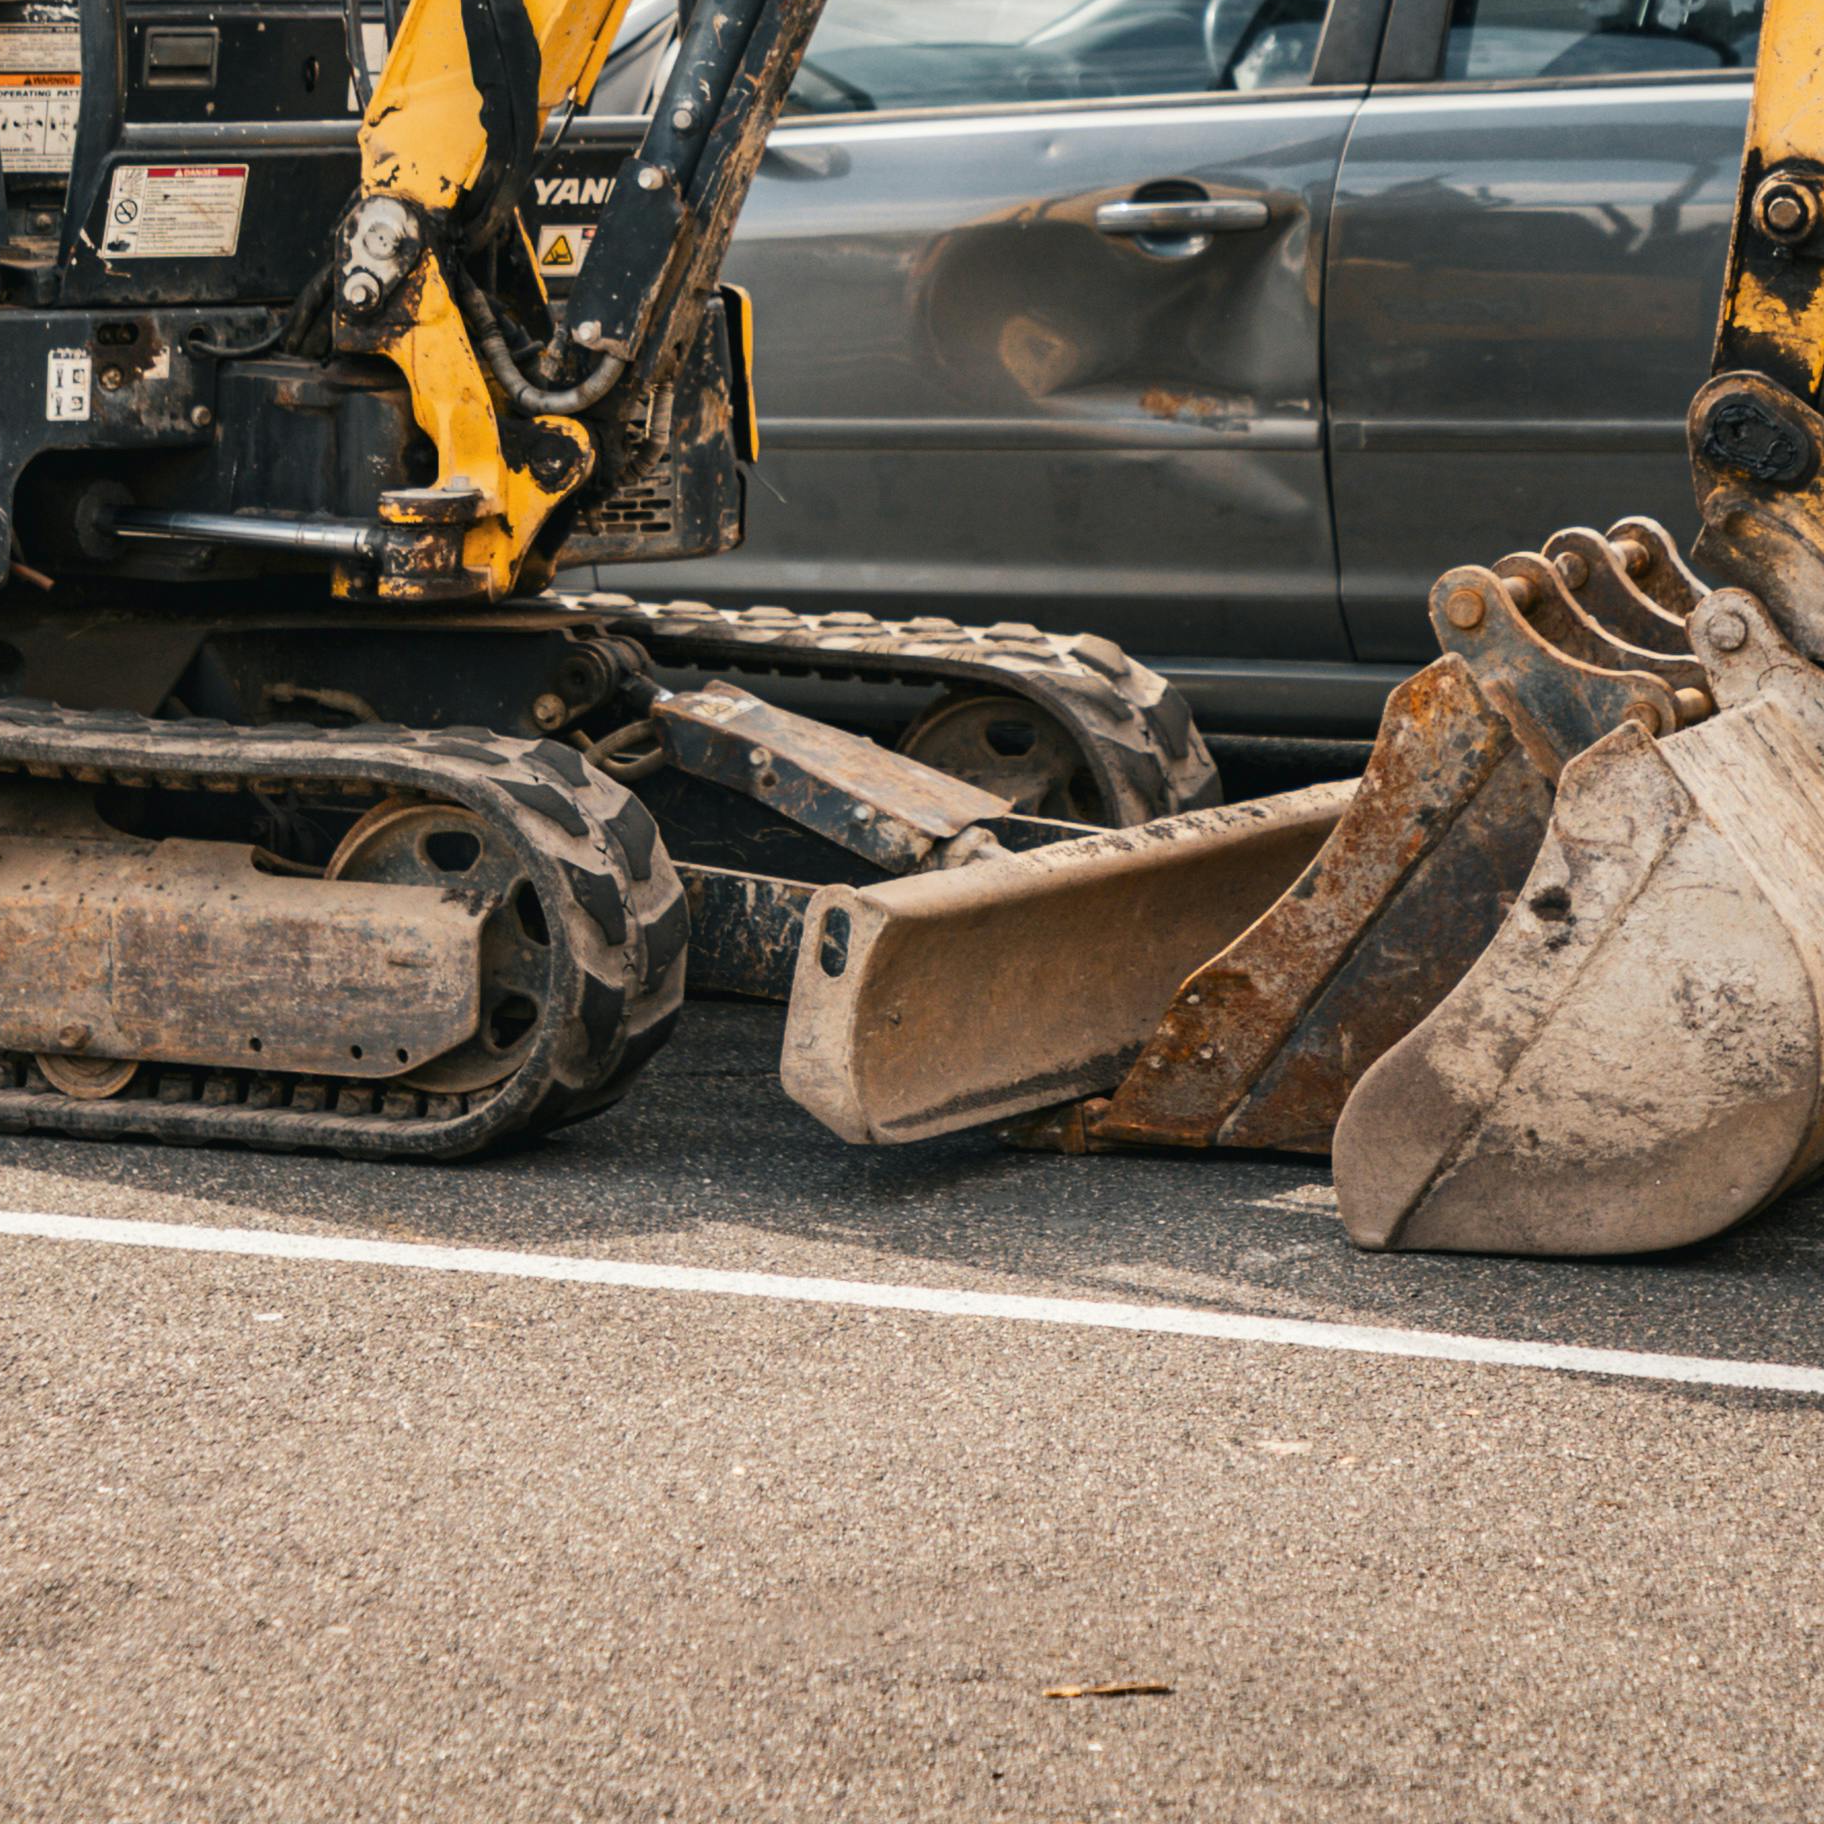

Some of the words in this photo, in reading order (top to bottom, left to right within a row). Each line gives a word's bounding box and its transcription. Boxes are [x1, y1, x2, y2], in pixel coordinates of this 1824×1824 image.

[33, 75, 76, 86] WARNING
[184, 168, 219, 177] DANGER
[534, 177, 617, 206] YAN
